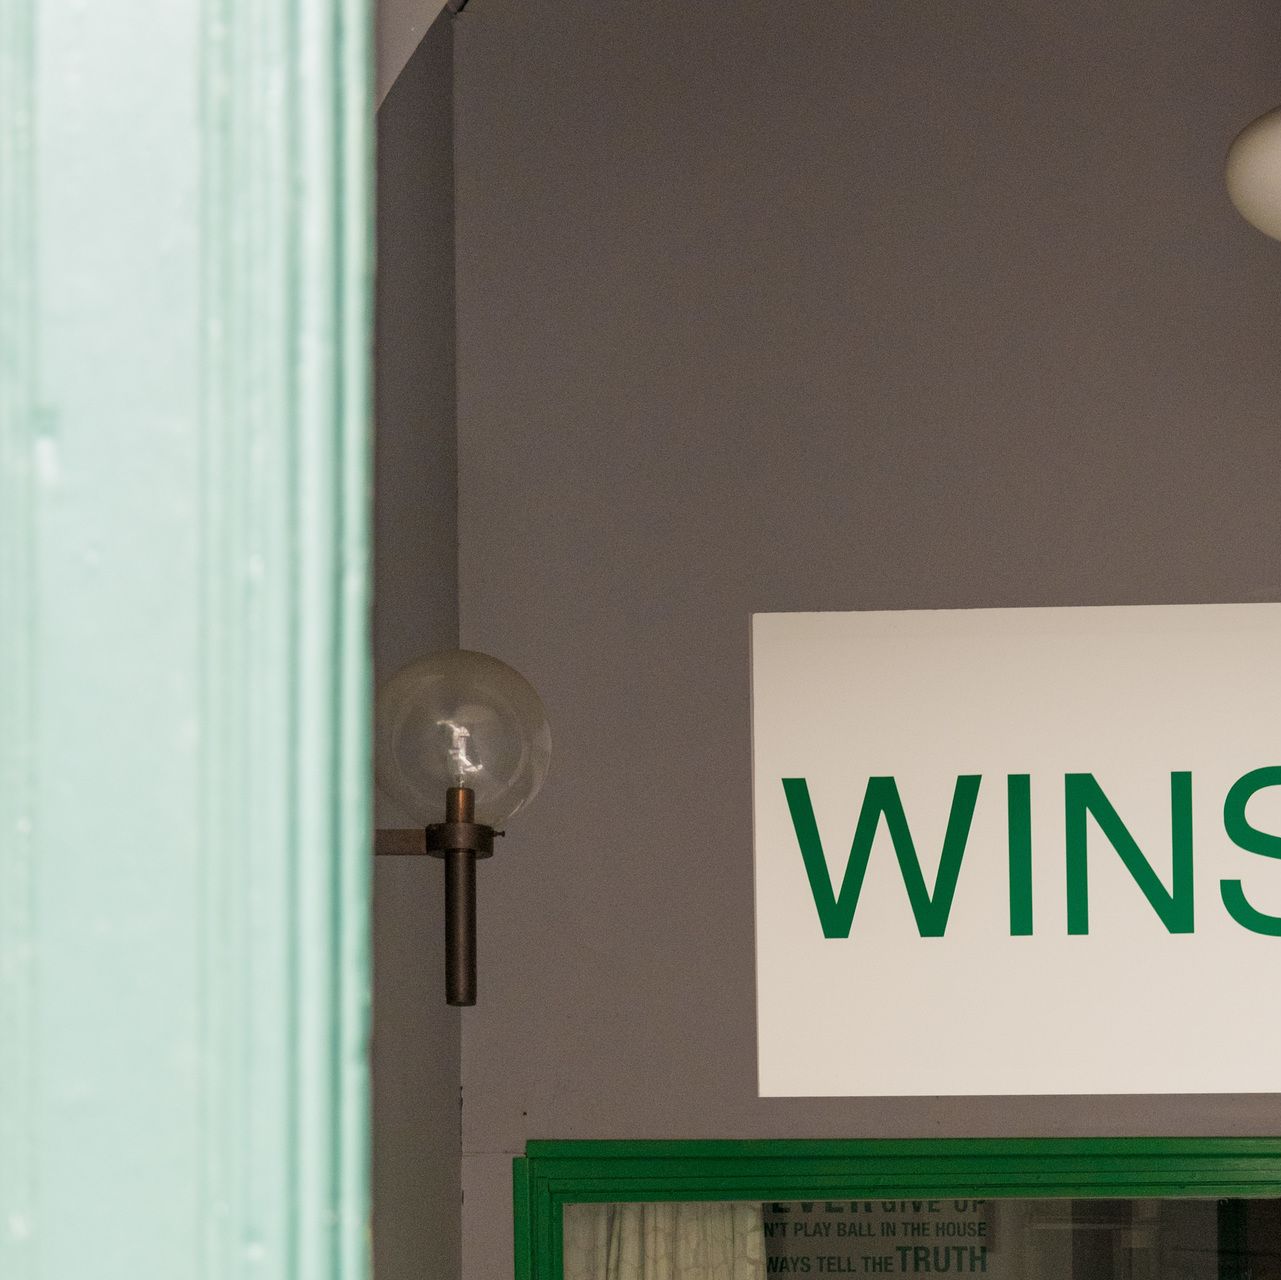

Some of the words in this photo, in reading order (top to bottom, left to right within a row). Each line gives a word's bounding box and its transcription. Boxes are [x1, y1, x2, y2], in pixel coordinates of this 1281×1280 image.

[764, 1222, 787, 1237] N'T
[794, 1222, 832, 1237] PLAY
[836, 1222, 876, 1237] BALL
[881, 1222, 896, 1237] IN
[902, 1222, 930, 1237] THE
[935, 1221, 987, 1237] HOUSE
[767, 1256, 811, 1273] WAYS
[816, 1256, 857, 1273] TELL
[861, 1256, 894, 1273] THE
[895, 1245, 988, 1273] TRUTH
